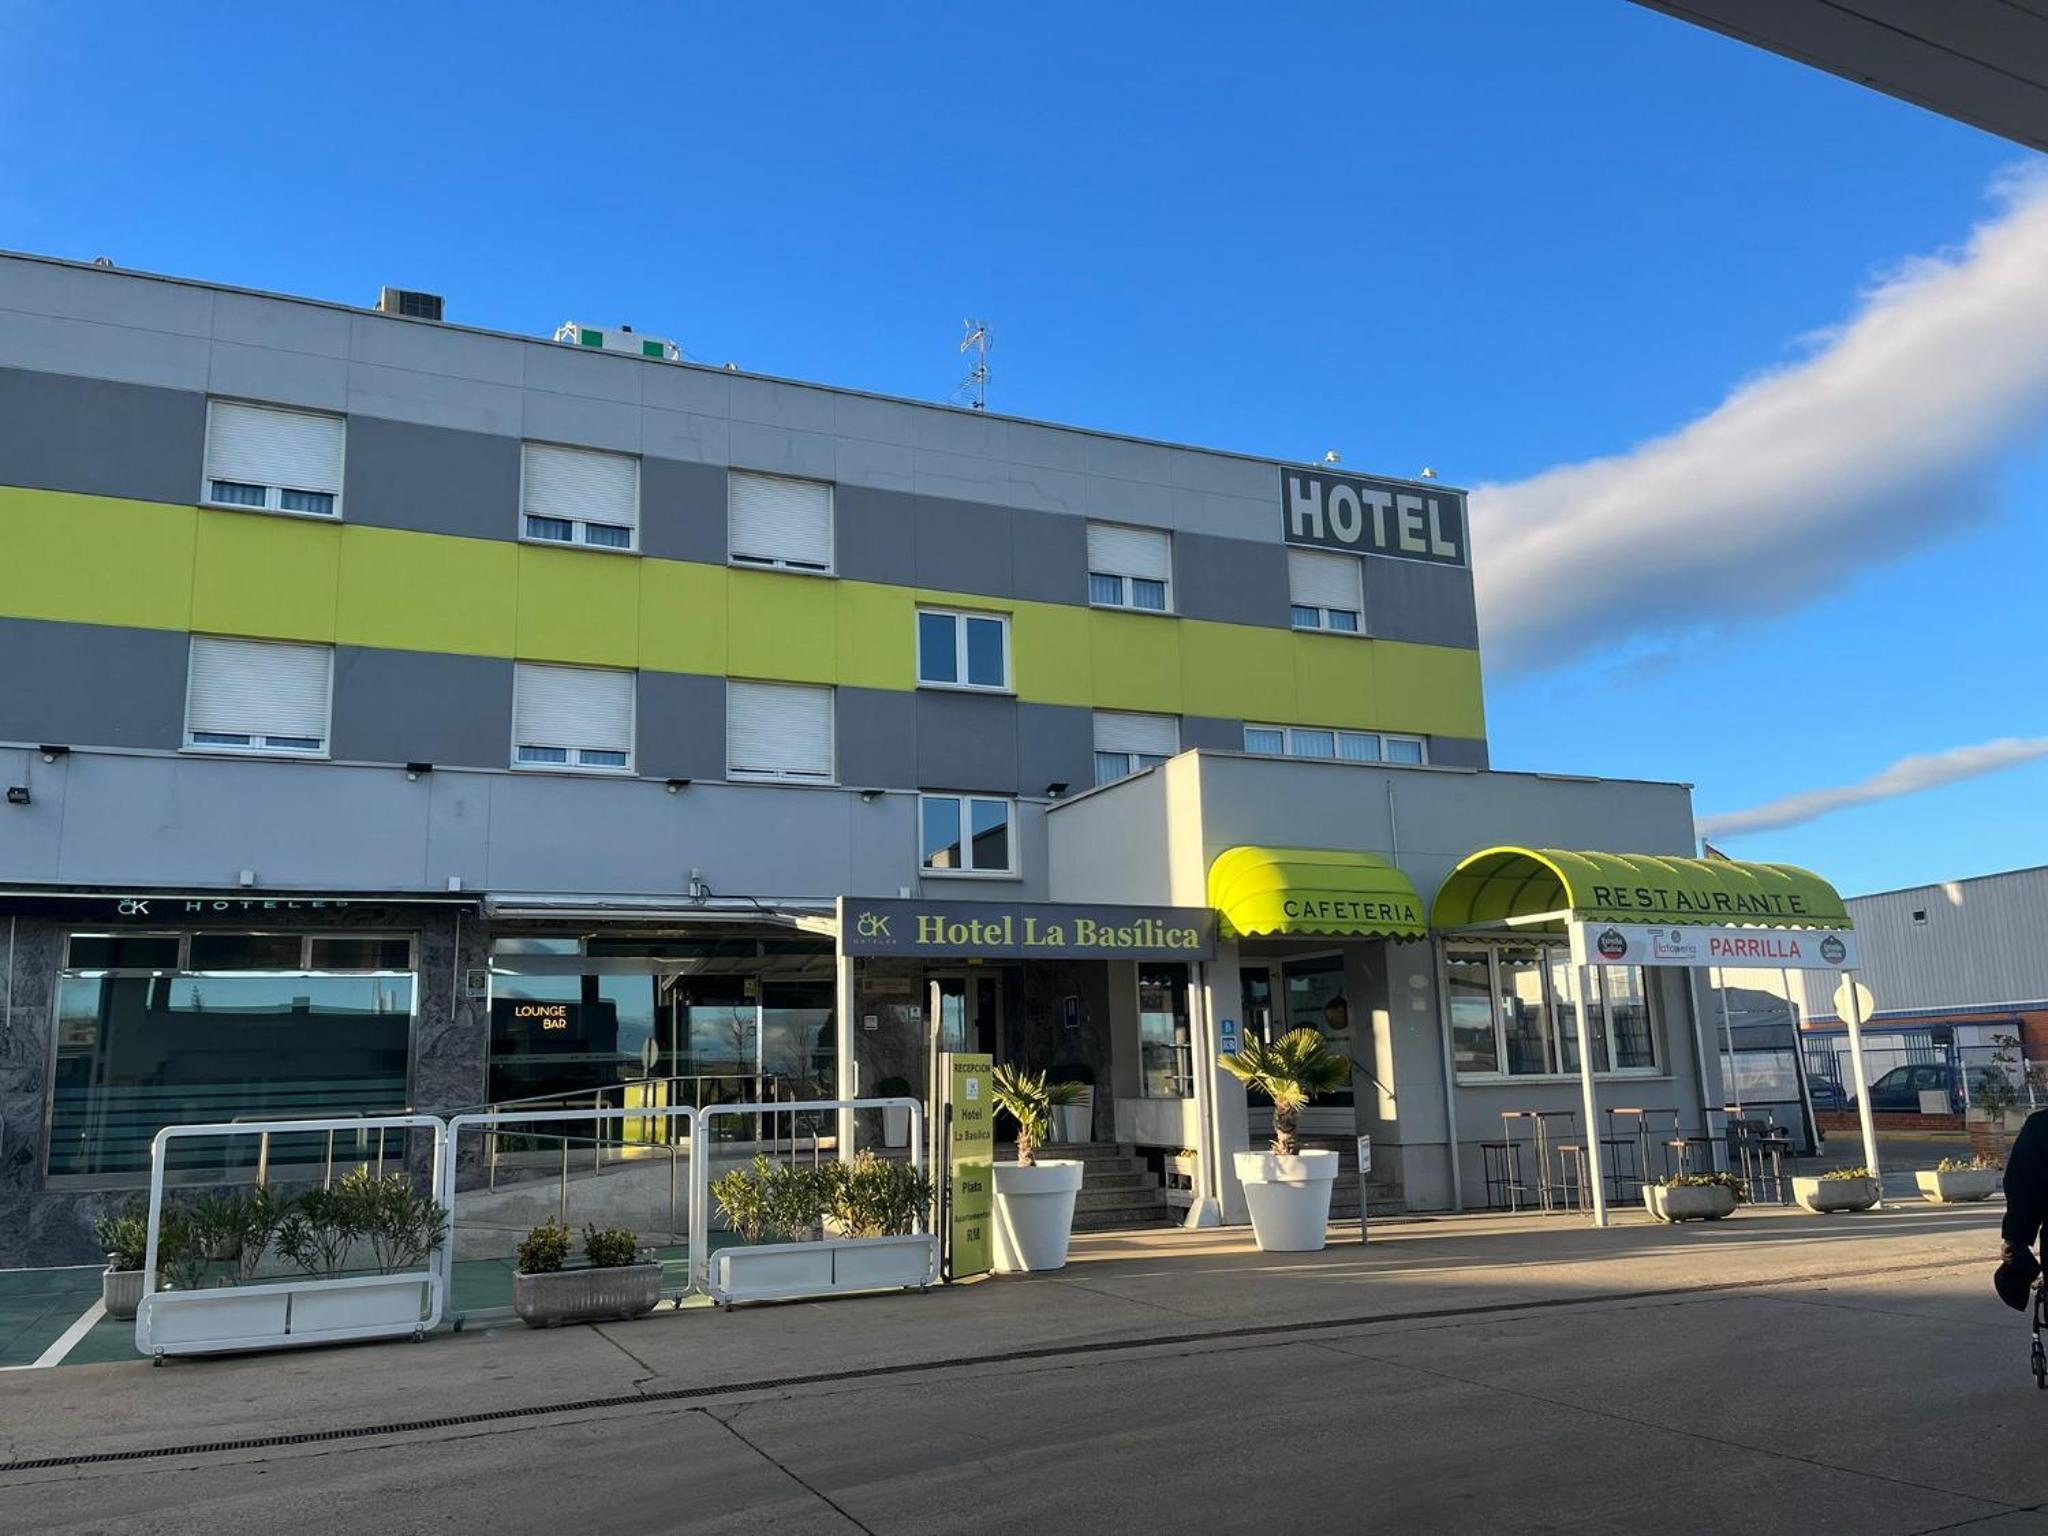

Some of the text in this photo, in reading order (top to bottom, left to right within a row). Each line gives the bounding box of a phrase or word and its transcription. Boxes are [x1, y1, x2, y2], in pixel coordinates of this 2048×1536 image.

[1289, 476, 1457, 558] HOTEL
[1592, 886, 1808, 914] RESTAURANTE
[1283, 900, 1417, 922] CAFETERIA
[915, 915, 1201, 949] Hotel La Basílica
[1709, 938, 1802, 959] PARRILLA
[515, 1005, 567, 1017] LOUNGE
[543, 1018, 567, 1030] BAR
[961, 1107, 983, 1121] Hotel
